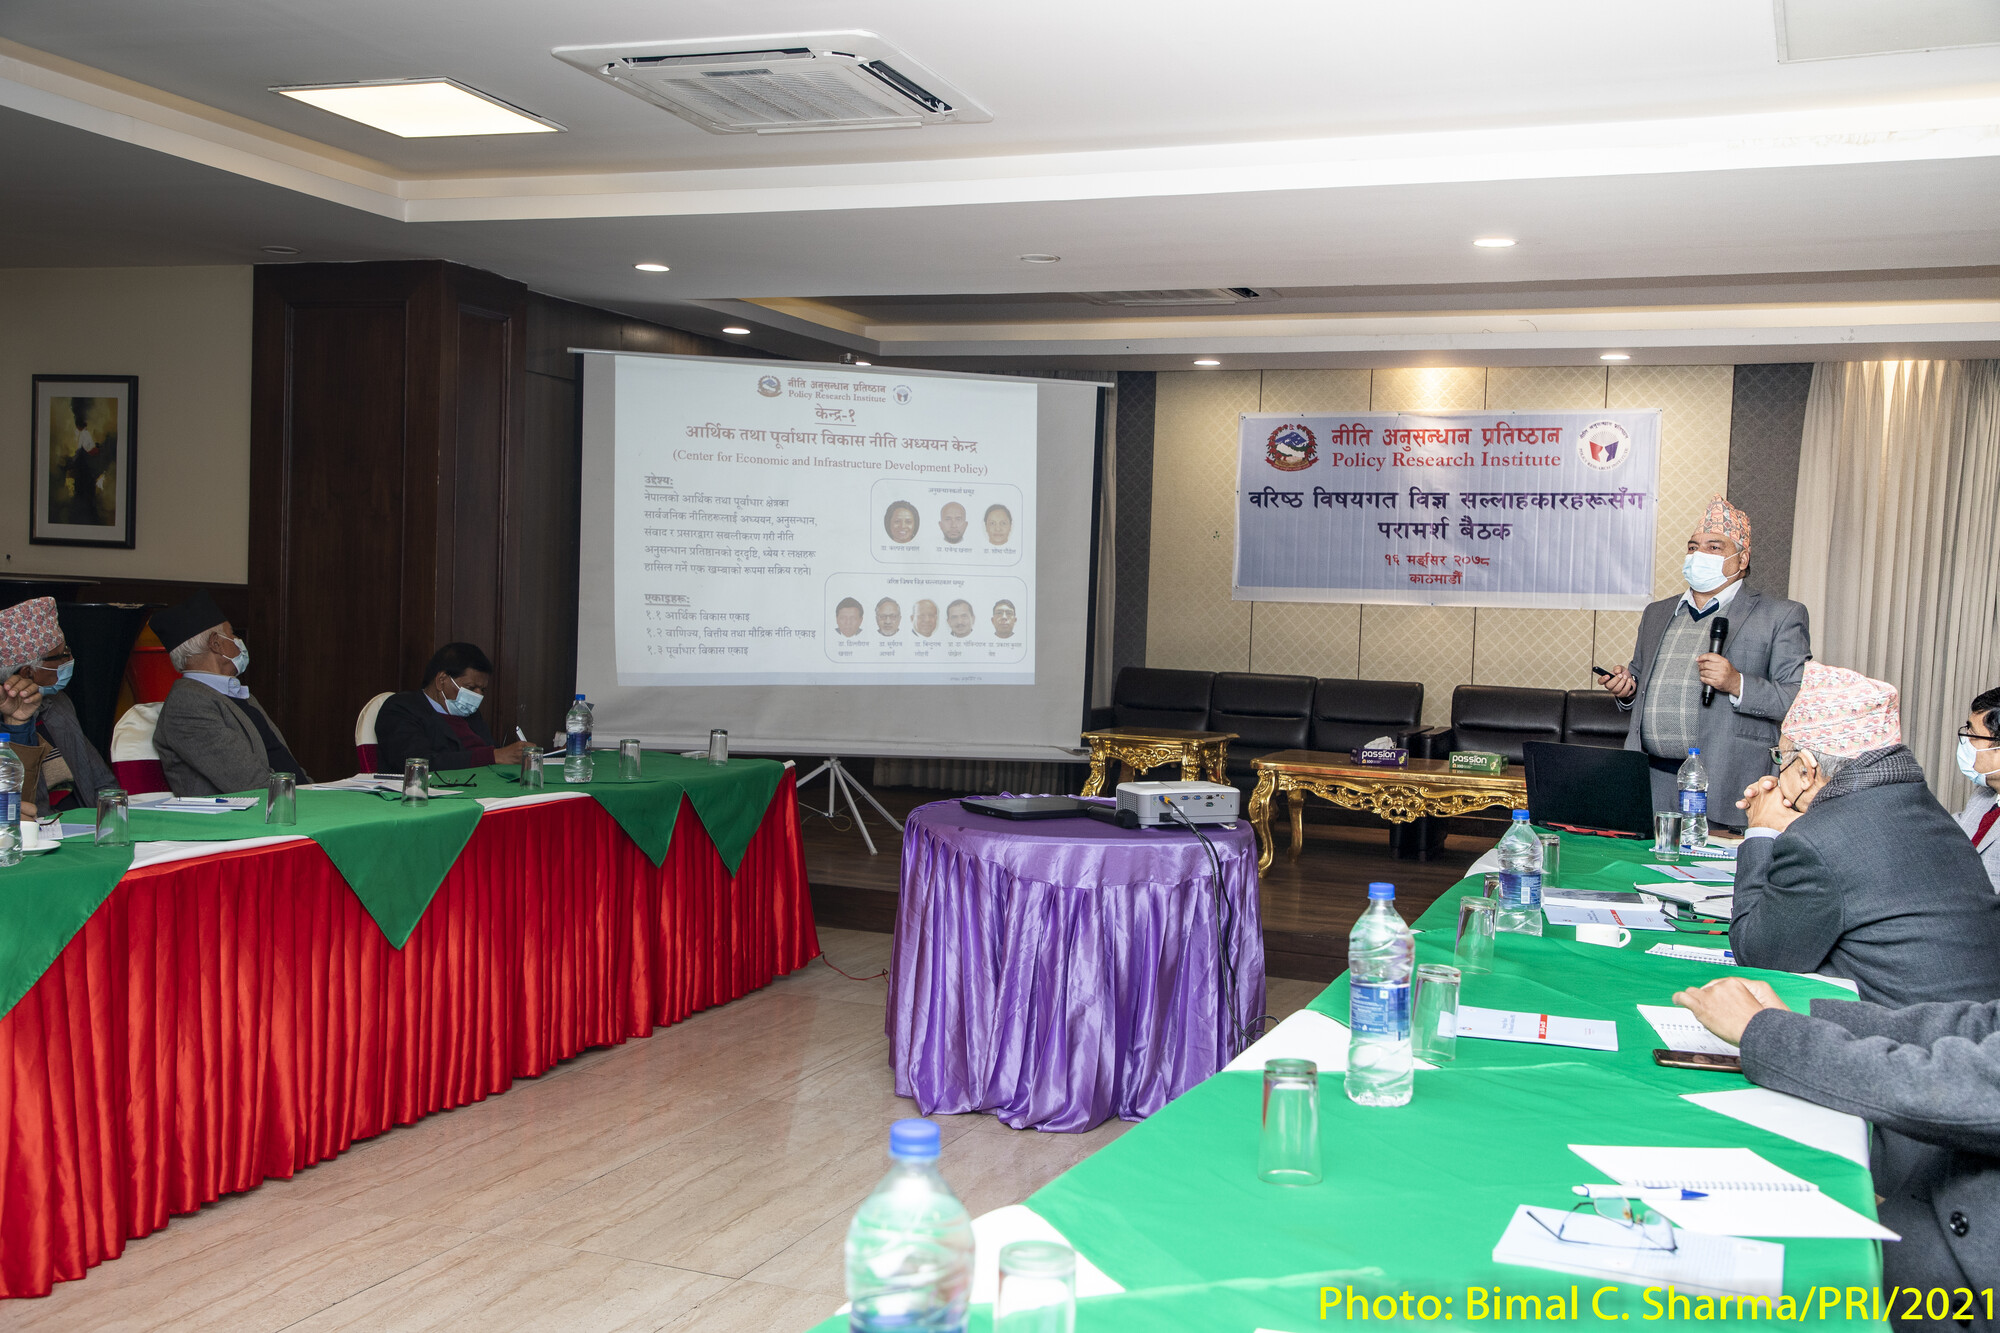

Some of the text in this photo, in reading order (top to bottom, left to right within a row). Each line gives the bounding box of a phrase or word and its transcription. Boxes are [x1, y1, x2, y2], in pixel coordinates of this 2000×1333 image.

[788, 377, 806, 389] नीति
[811, 380, 849, 394] अनुसन्धान
[853, 381, 886, 394] प्रतिष्ठान
[788, 389, 886, 403] Policy Research Institute
[815, 403, 856, 423] केन्द्र-१
[685, 422, 978, 453] आर्थिक तथा पूर्वाधार विकास नीति अध्ययन केन्द्र
[1332, 421, 1563, 452] नीति अनुसन्धान प्रतिष्ठान
[673, 449, 988, 477] (Center for Economic and Infrastructure Development Policy)
[1332, 451, 1561, 471] Policy Research Institute
[644, 489, 789, 510] नेपालको आर्थिक तथा पूर्वाधार क्षेत्रका
[1249, 486, 1646, 510] वरिष्ठ विषयगत विज्ञ सल्लाहकारहरूसँग
[644, 507, 686, 520] सार्वजनिक
[689, 509, 737, 524] नीतिहरूलाई
[763, 530, 775, 541] गरी
[777, 530, 794, 541] नीति
[1378, 515, 1513, 540] परामर्श बैठक
[645, 545, 687, 558] अनुसन्धान
[644, 560, 672, 572] हासिल
[690, 564, 705, 575] एक
[1384, 554, 1400, 567] १६
[1454, 555, 1490, 567] २०७८
[665, 608, 697, 621] आर्थिक
[699, 609, 726, 621] विकास
[729, 612, 750, 622] एकाइ
[730, 629, 746, 638] तथा
[775, 626, 792, 638] नीति
[794, 629, 816, 640] एकाइ
[666, 643, 697, 658] पूर्वाधार
[699, 644, 725, 655] विकास
[727, 646, 749, 657] एकाइ
[1361, 750, 1396, 760] passion
[1452, 754, 1487, 764] passion
